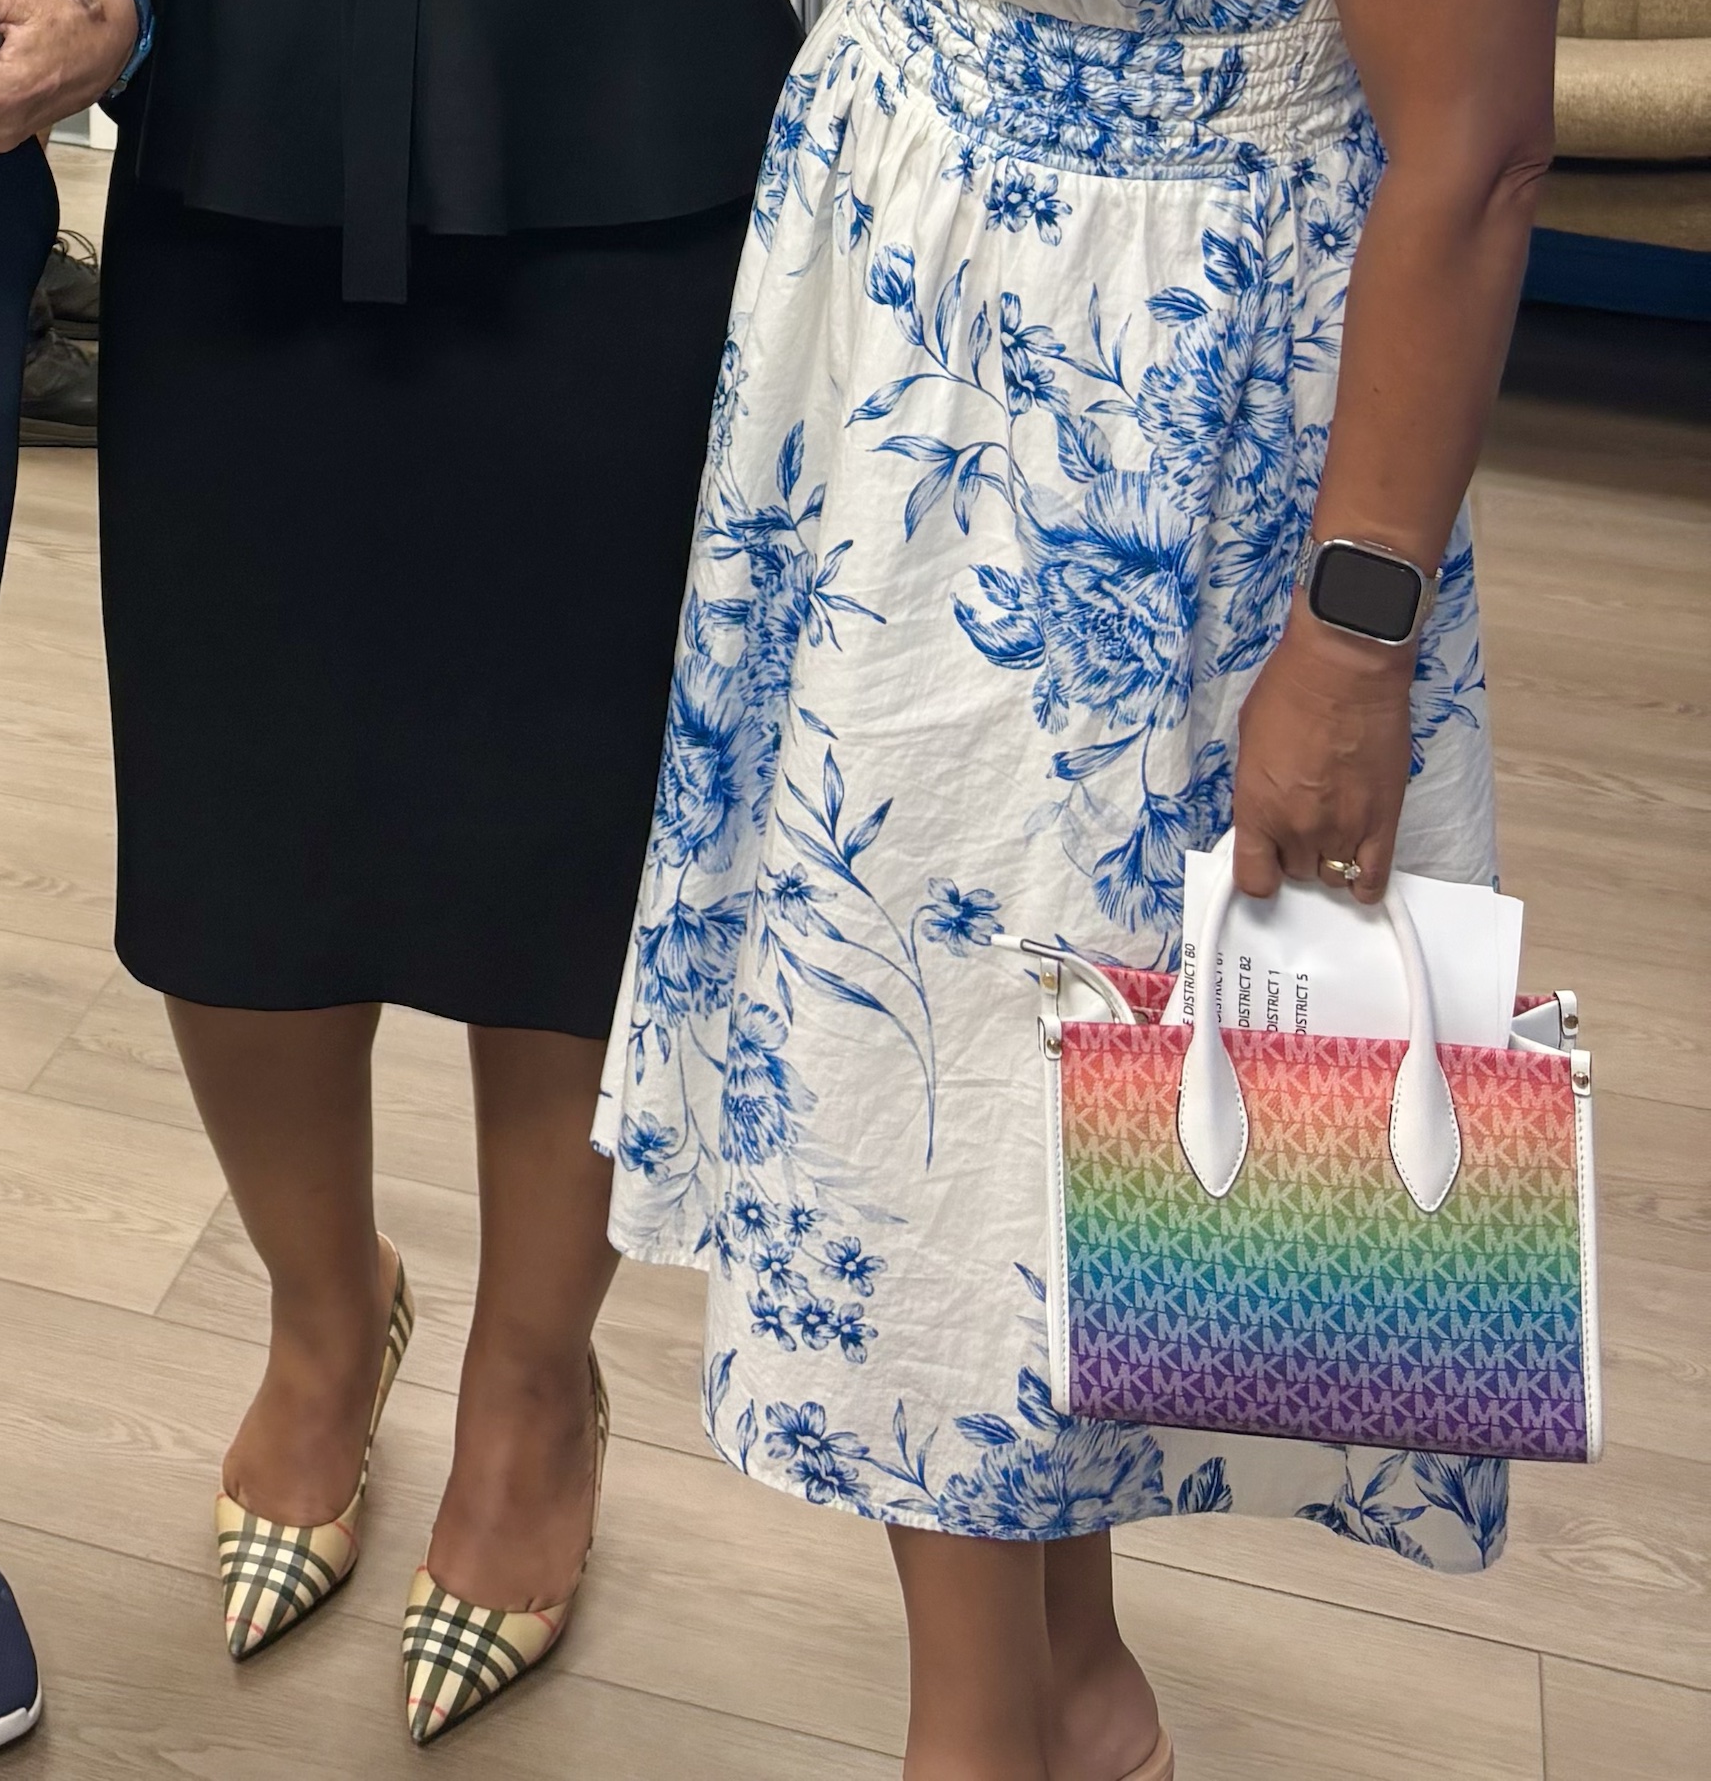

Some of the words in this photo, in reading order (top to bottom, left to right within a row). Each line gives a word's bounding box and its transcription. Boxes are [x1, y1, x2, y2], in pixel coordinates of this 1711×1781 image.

[1183, 960, 1195, 1016] DISTRICT
[1238, 973, 1251, 1028] DISTRICT
[1296, 973, 1308, 982] 5
[1267, 979, 1279, 1032] DISTRICT
[1295, 984, 1308, 1035] DISTRICT
